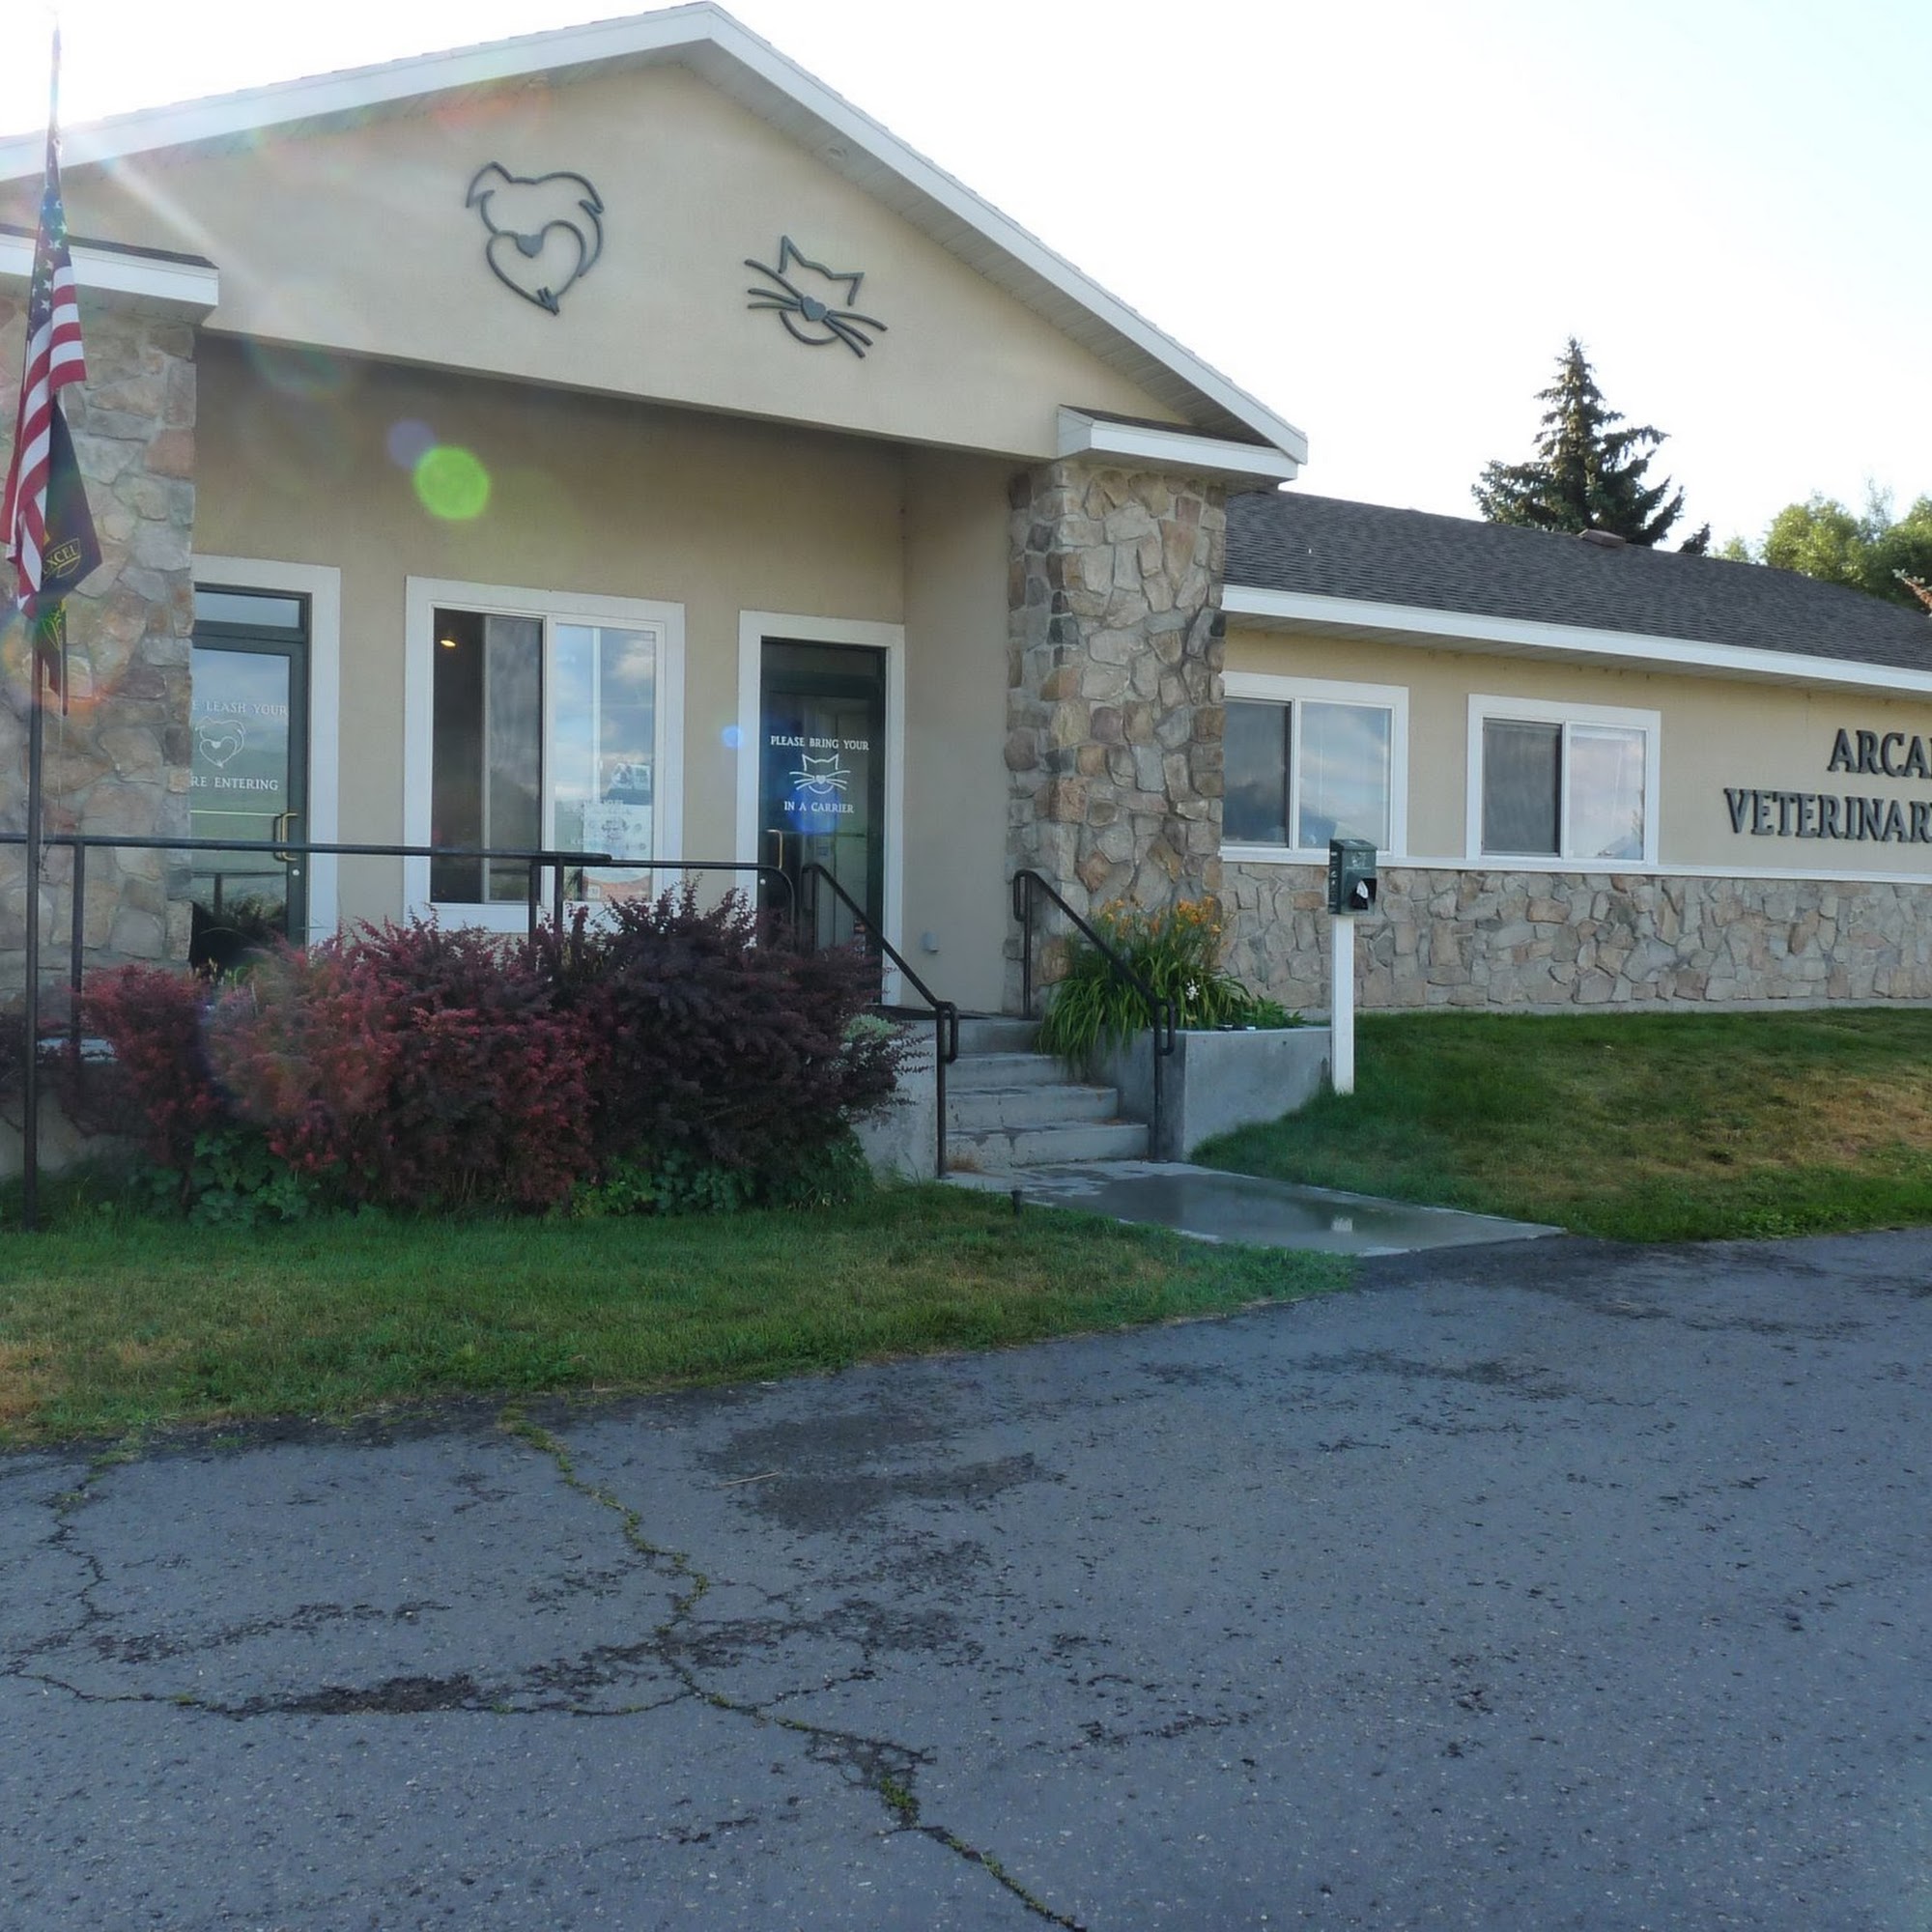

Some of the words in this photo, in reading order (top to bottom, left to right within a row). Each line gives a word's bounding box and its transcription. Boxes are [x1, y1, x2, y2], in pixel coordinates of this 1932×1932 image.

[207, 701, 246, 714] LEASH
[254, 704, 288, 716] YOUR
[770, 735, 806, 747] PLEASE
[810, 738, 838, 750] BRING
[843, 740, 869, 751] YOUR
[1826, 728, 1932, 779] ARCA
[214, 777, 279, 791] ENTERING
[784, 801, 795, 811] IN
[799, 802, 808, 811] A
[811, 803, 854, 813] CARRIER
[1723, 787, 1932, 842] VETERINAR
